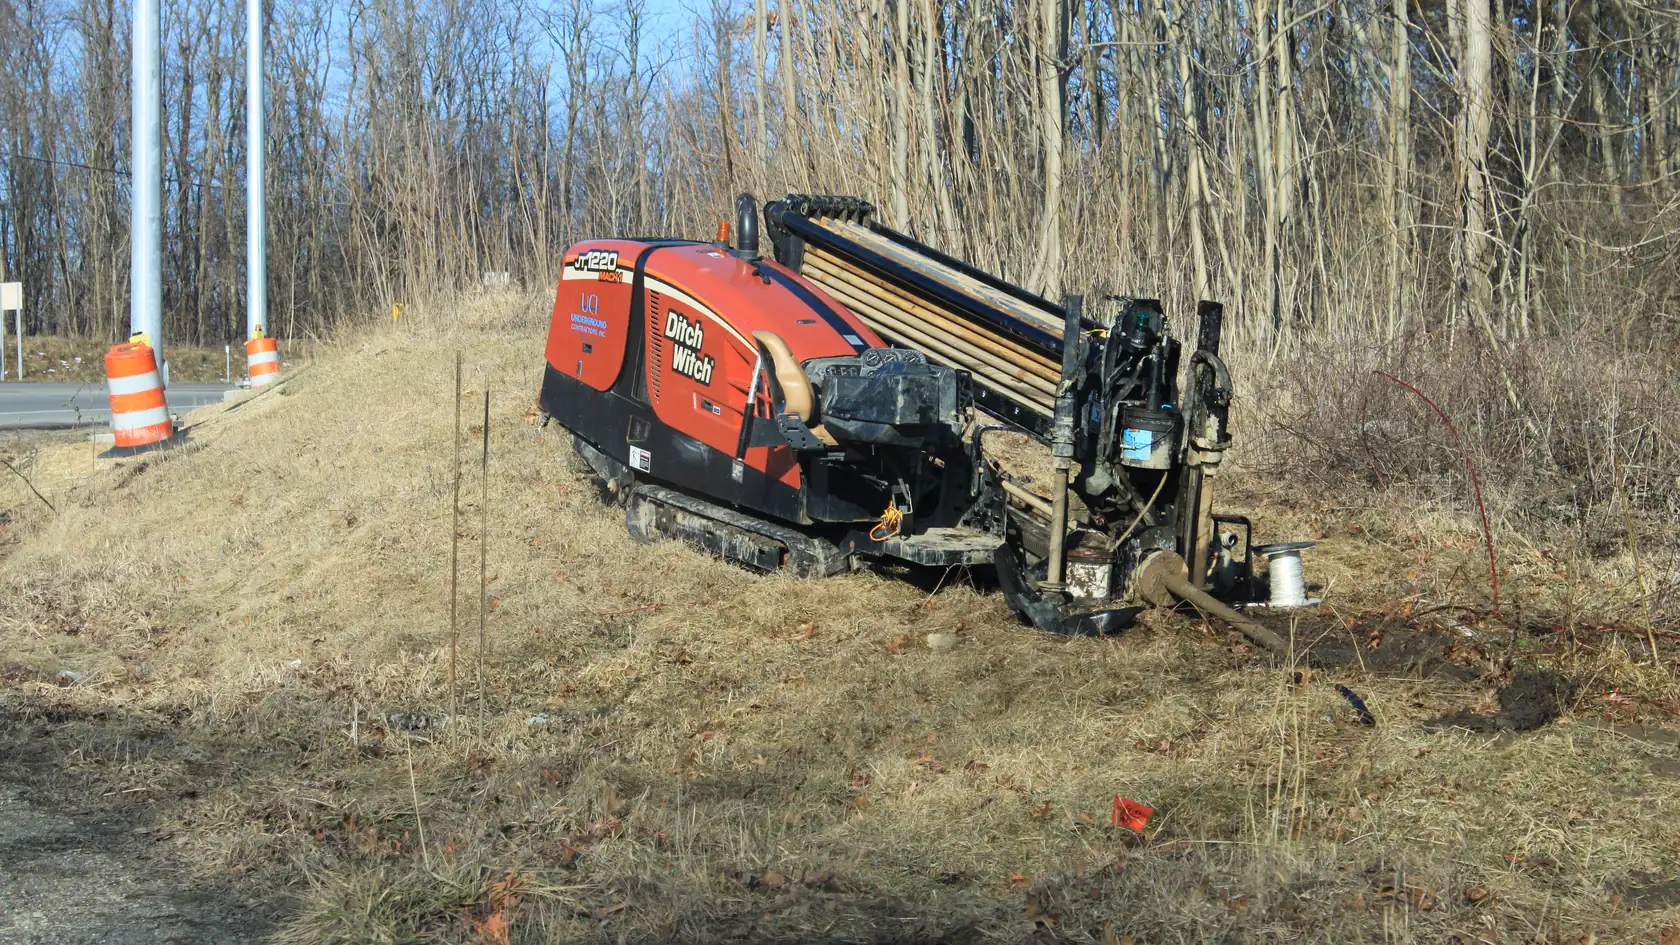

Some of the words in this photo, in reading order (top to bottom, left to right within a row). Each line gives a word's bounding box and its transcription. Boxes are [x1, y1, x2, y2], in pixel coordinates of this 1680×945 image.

[571, 312, 607, 329] UNDERGROUND
[665, 311, 703, 349] Ditch
[673, 343, 712, 384] Witch
